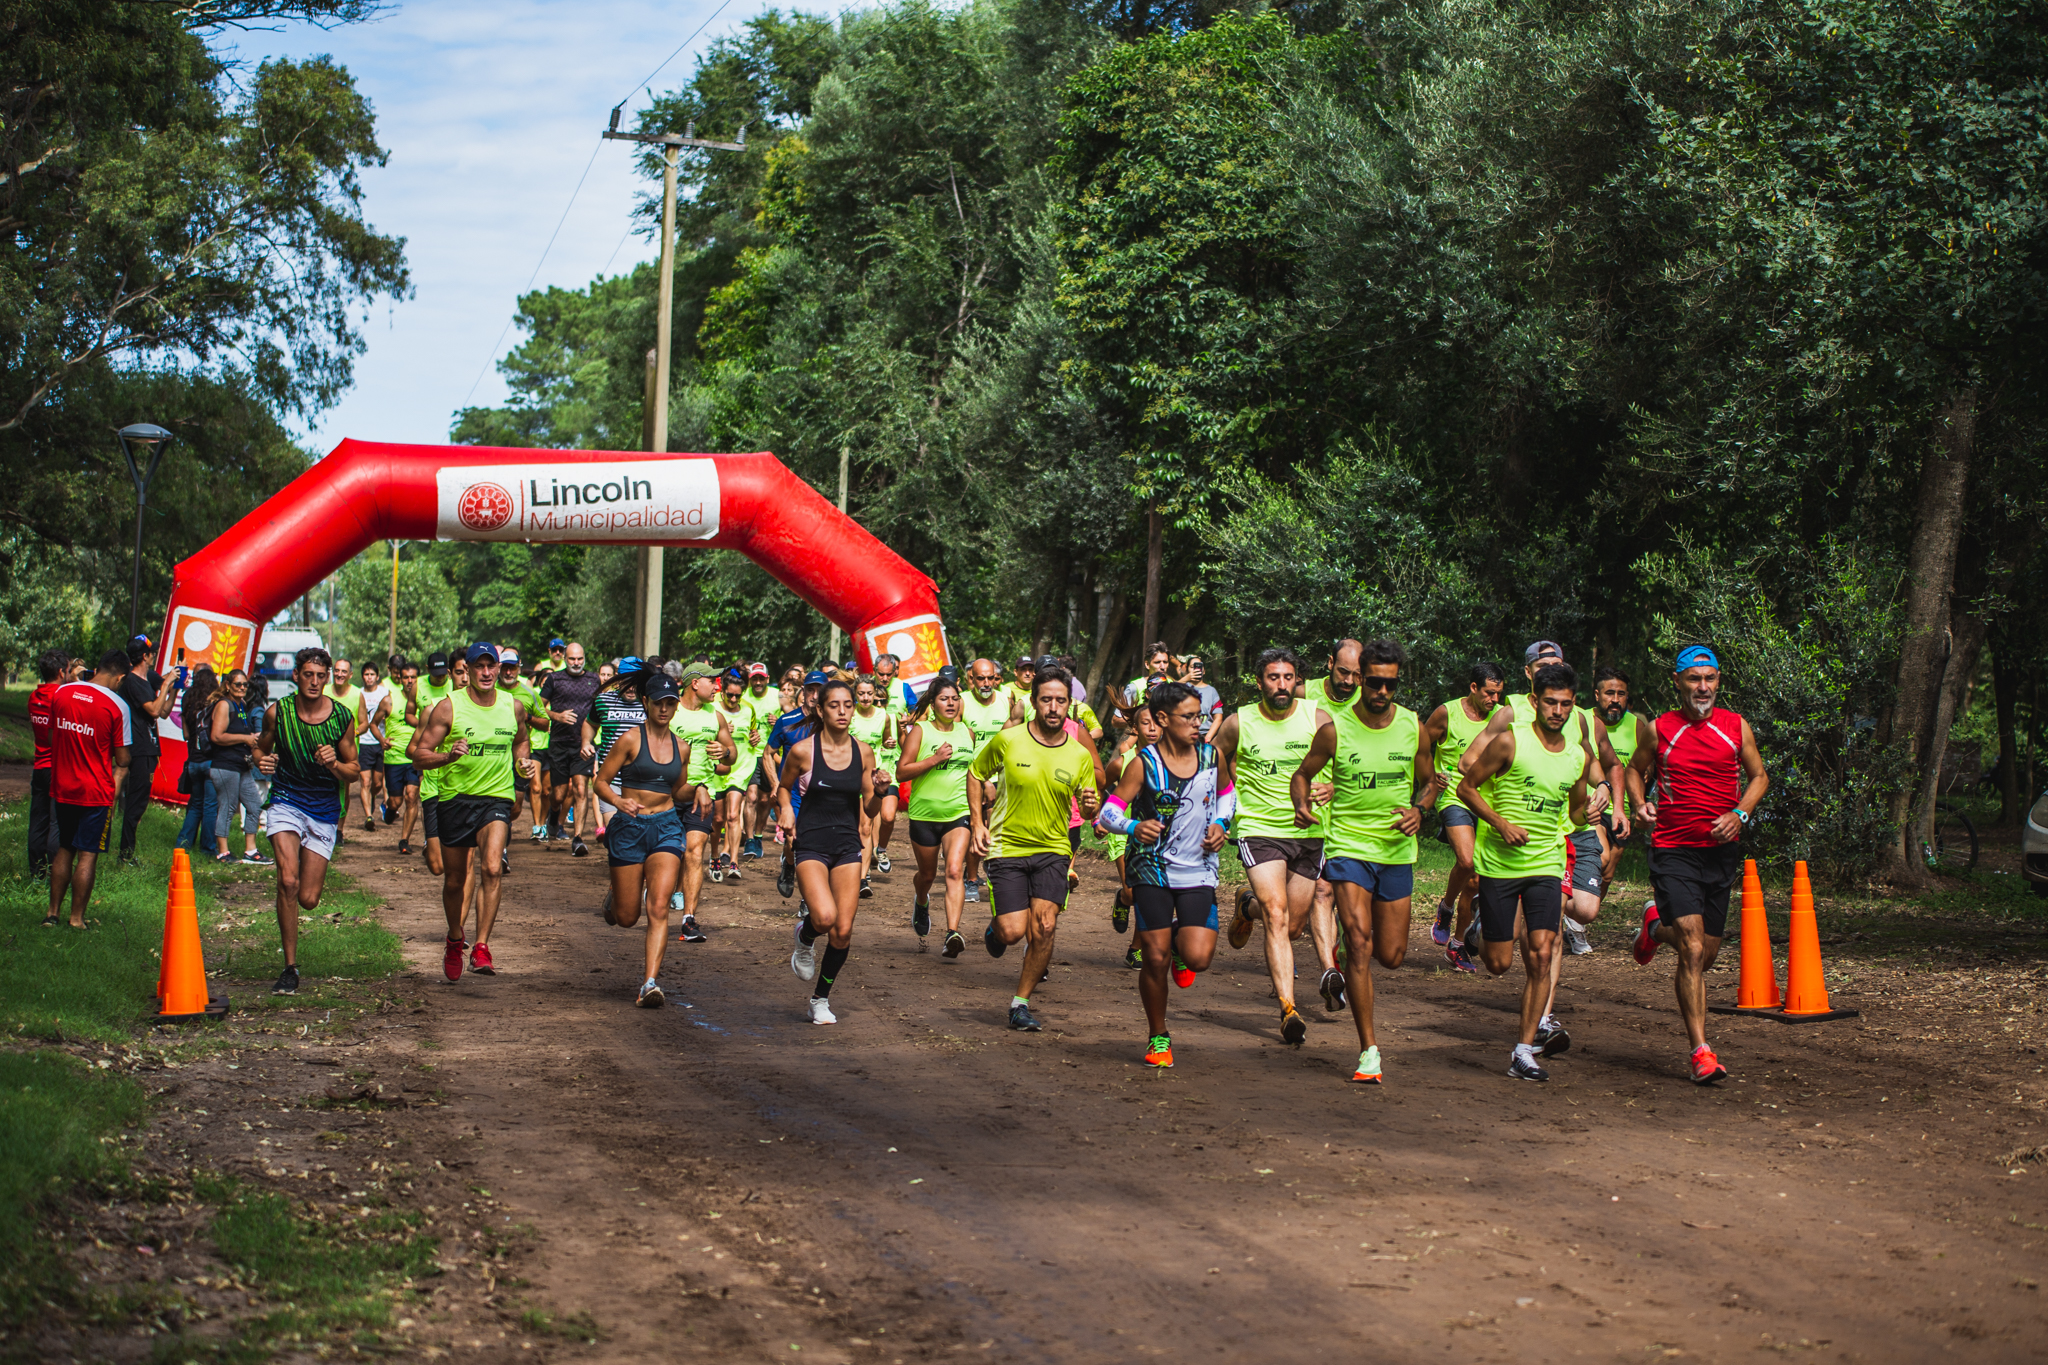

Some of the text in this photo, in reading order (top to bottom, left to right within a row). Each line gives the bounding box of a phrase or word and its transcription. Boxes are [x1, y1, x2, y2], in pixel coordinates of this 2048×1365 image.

[530, 475, 653, 507] Lincoln
[530, 502, 703, 533] Municipalidad
[57, 717, 94, 736] Lincoln
